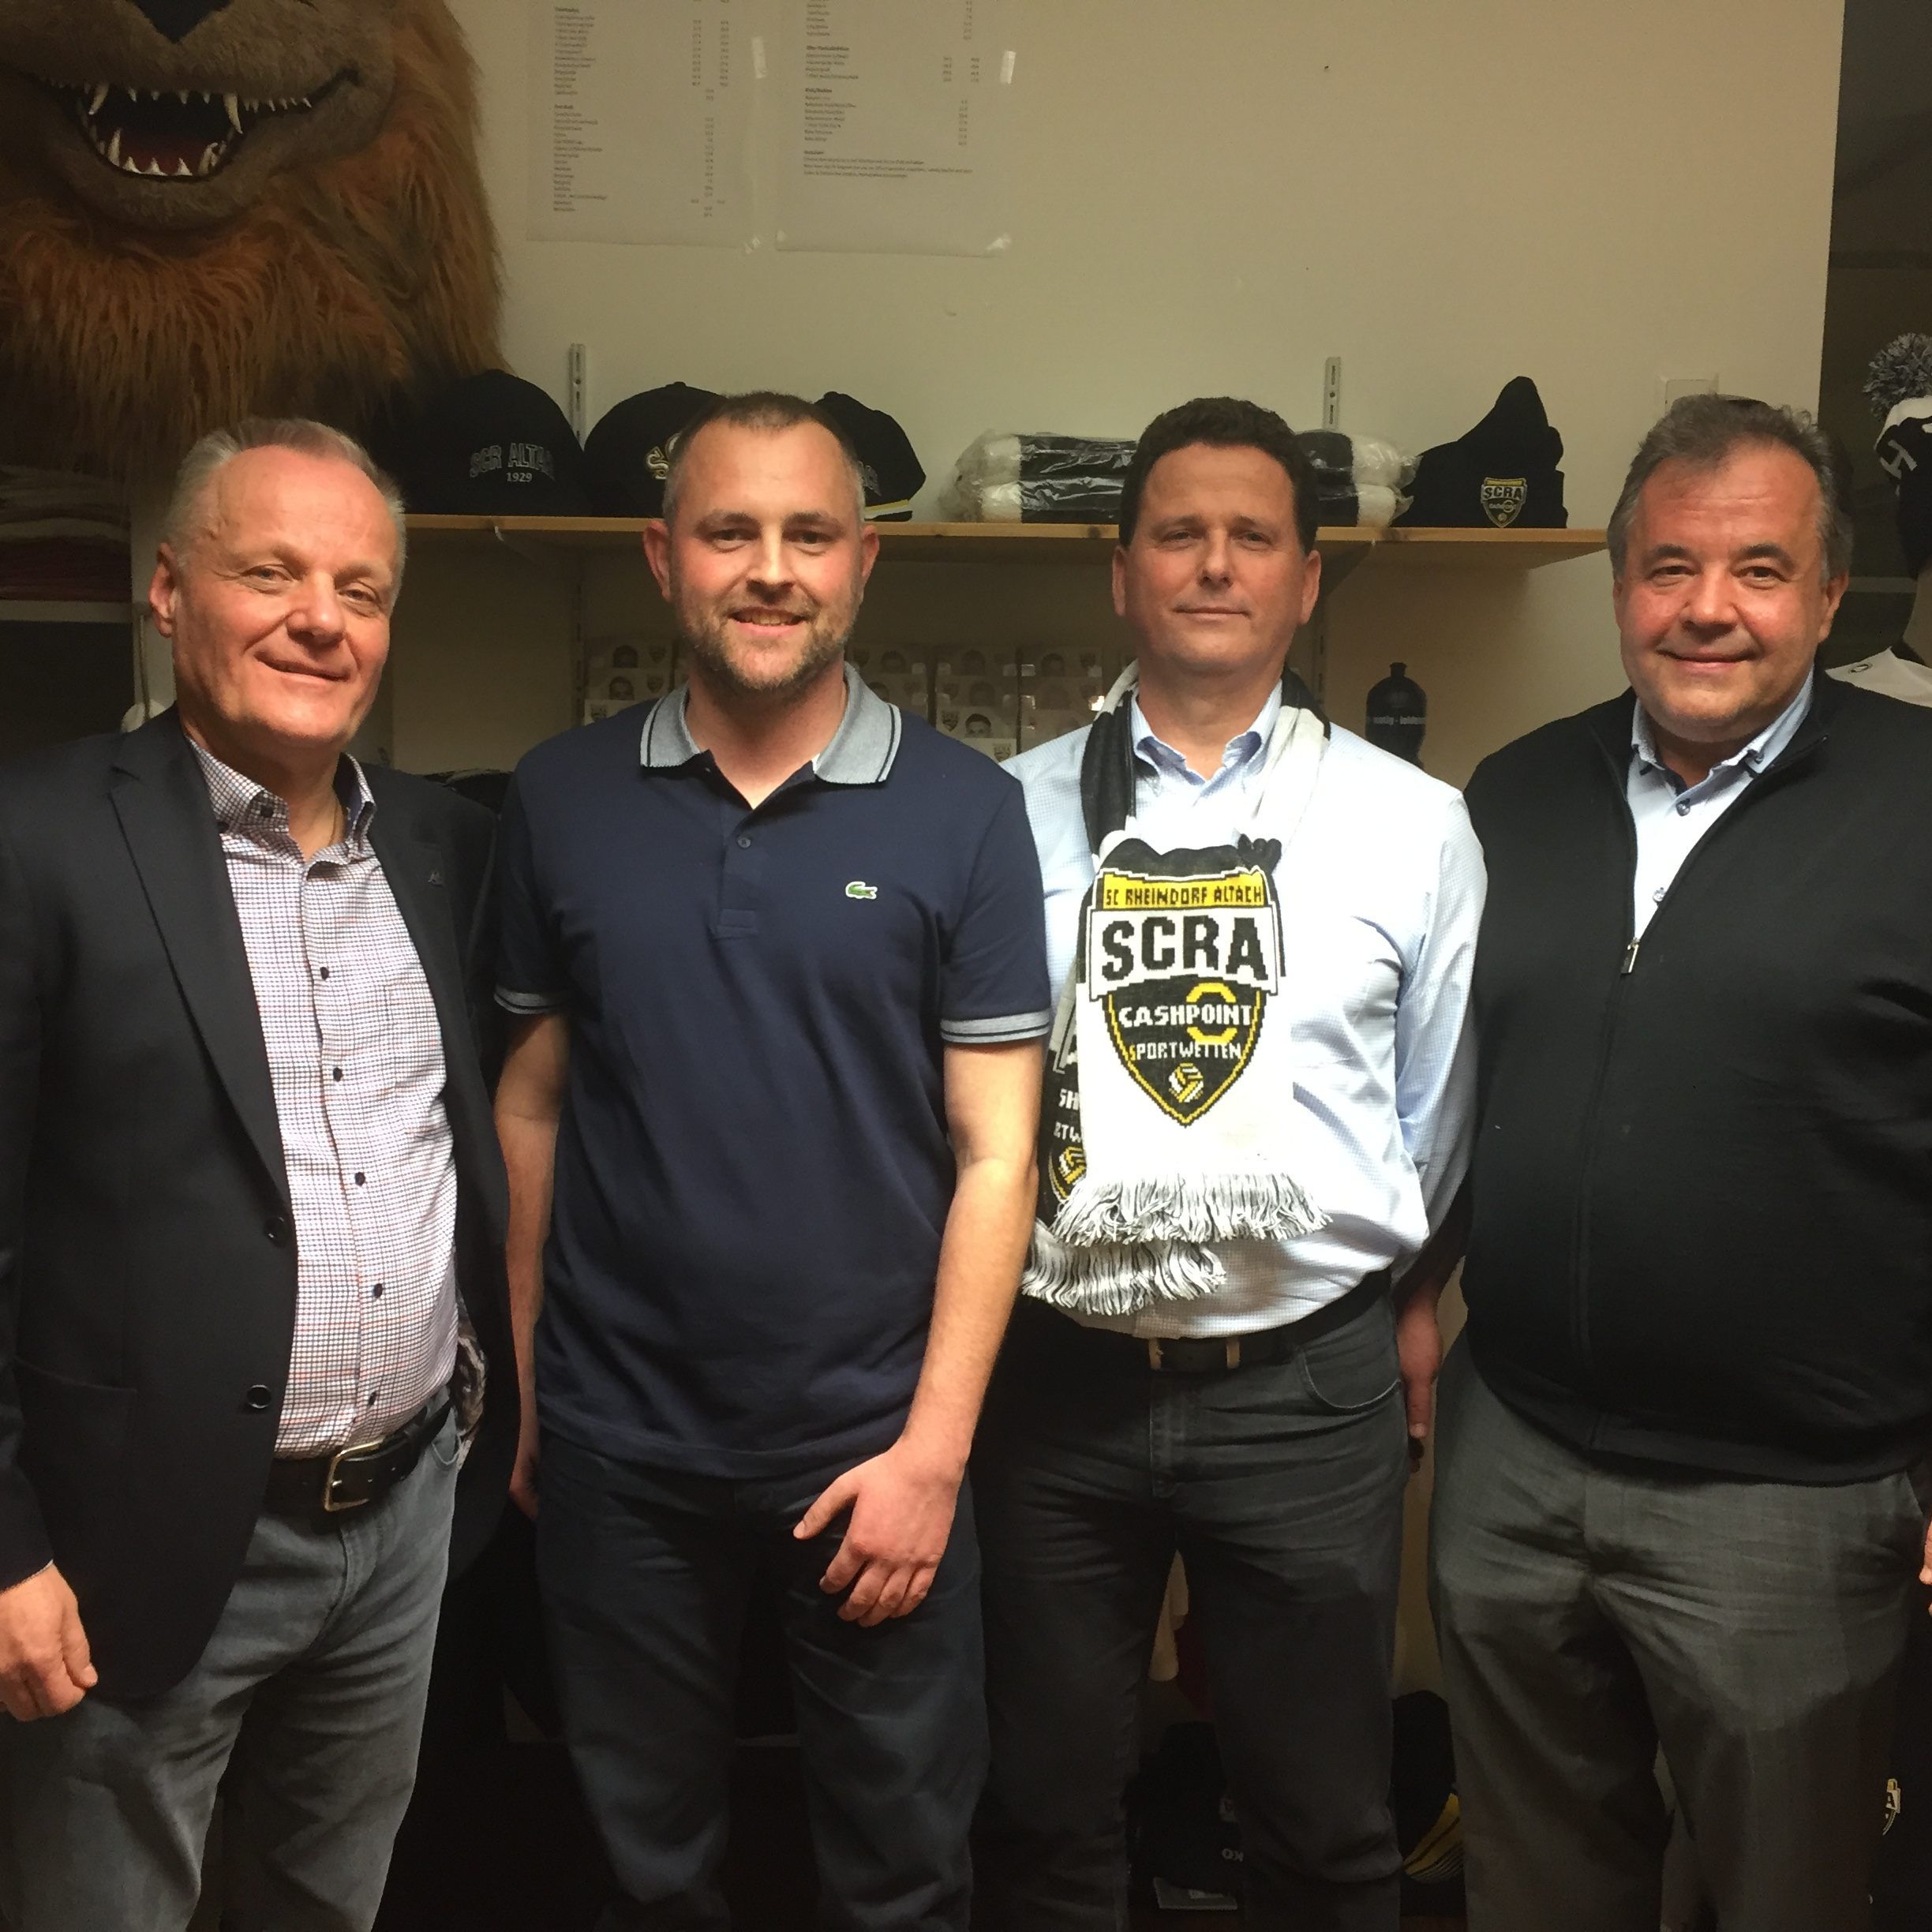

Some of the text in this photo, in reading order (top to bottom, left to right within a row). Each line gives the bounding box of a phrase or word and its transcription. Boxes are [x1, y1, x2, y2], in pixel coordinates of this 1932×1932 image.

[507, 473, 533, 482] 1929
[1484, 486, 1522, 500] SCRA
[1106, 885, 1262, 905] SC RHEINDORF ALTACH
[1102, 915, 1268, 981] SCRA
[1118, 1004, 1252, 1028] CASHPOINT
